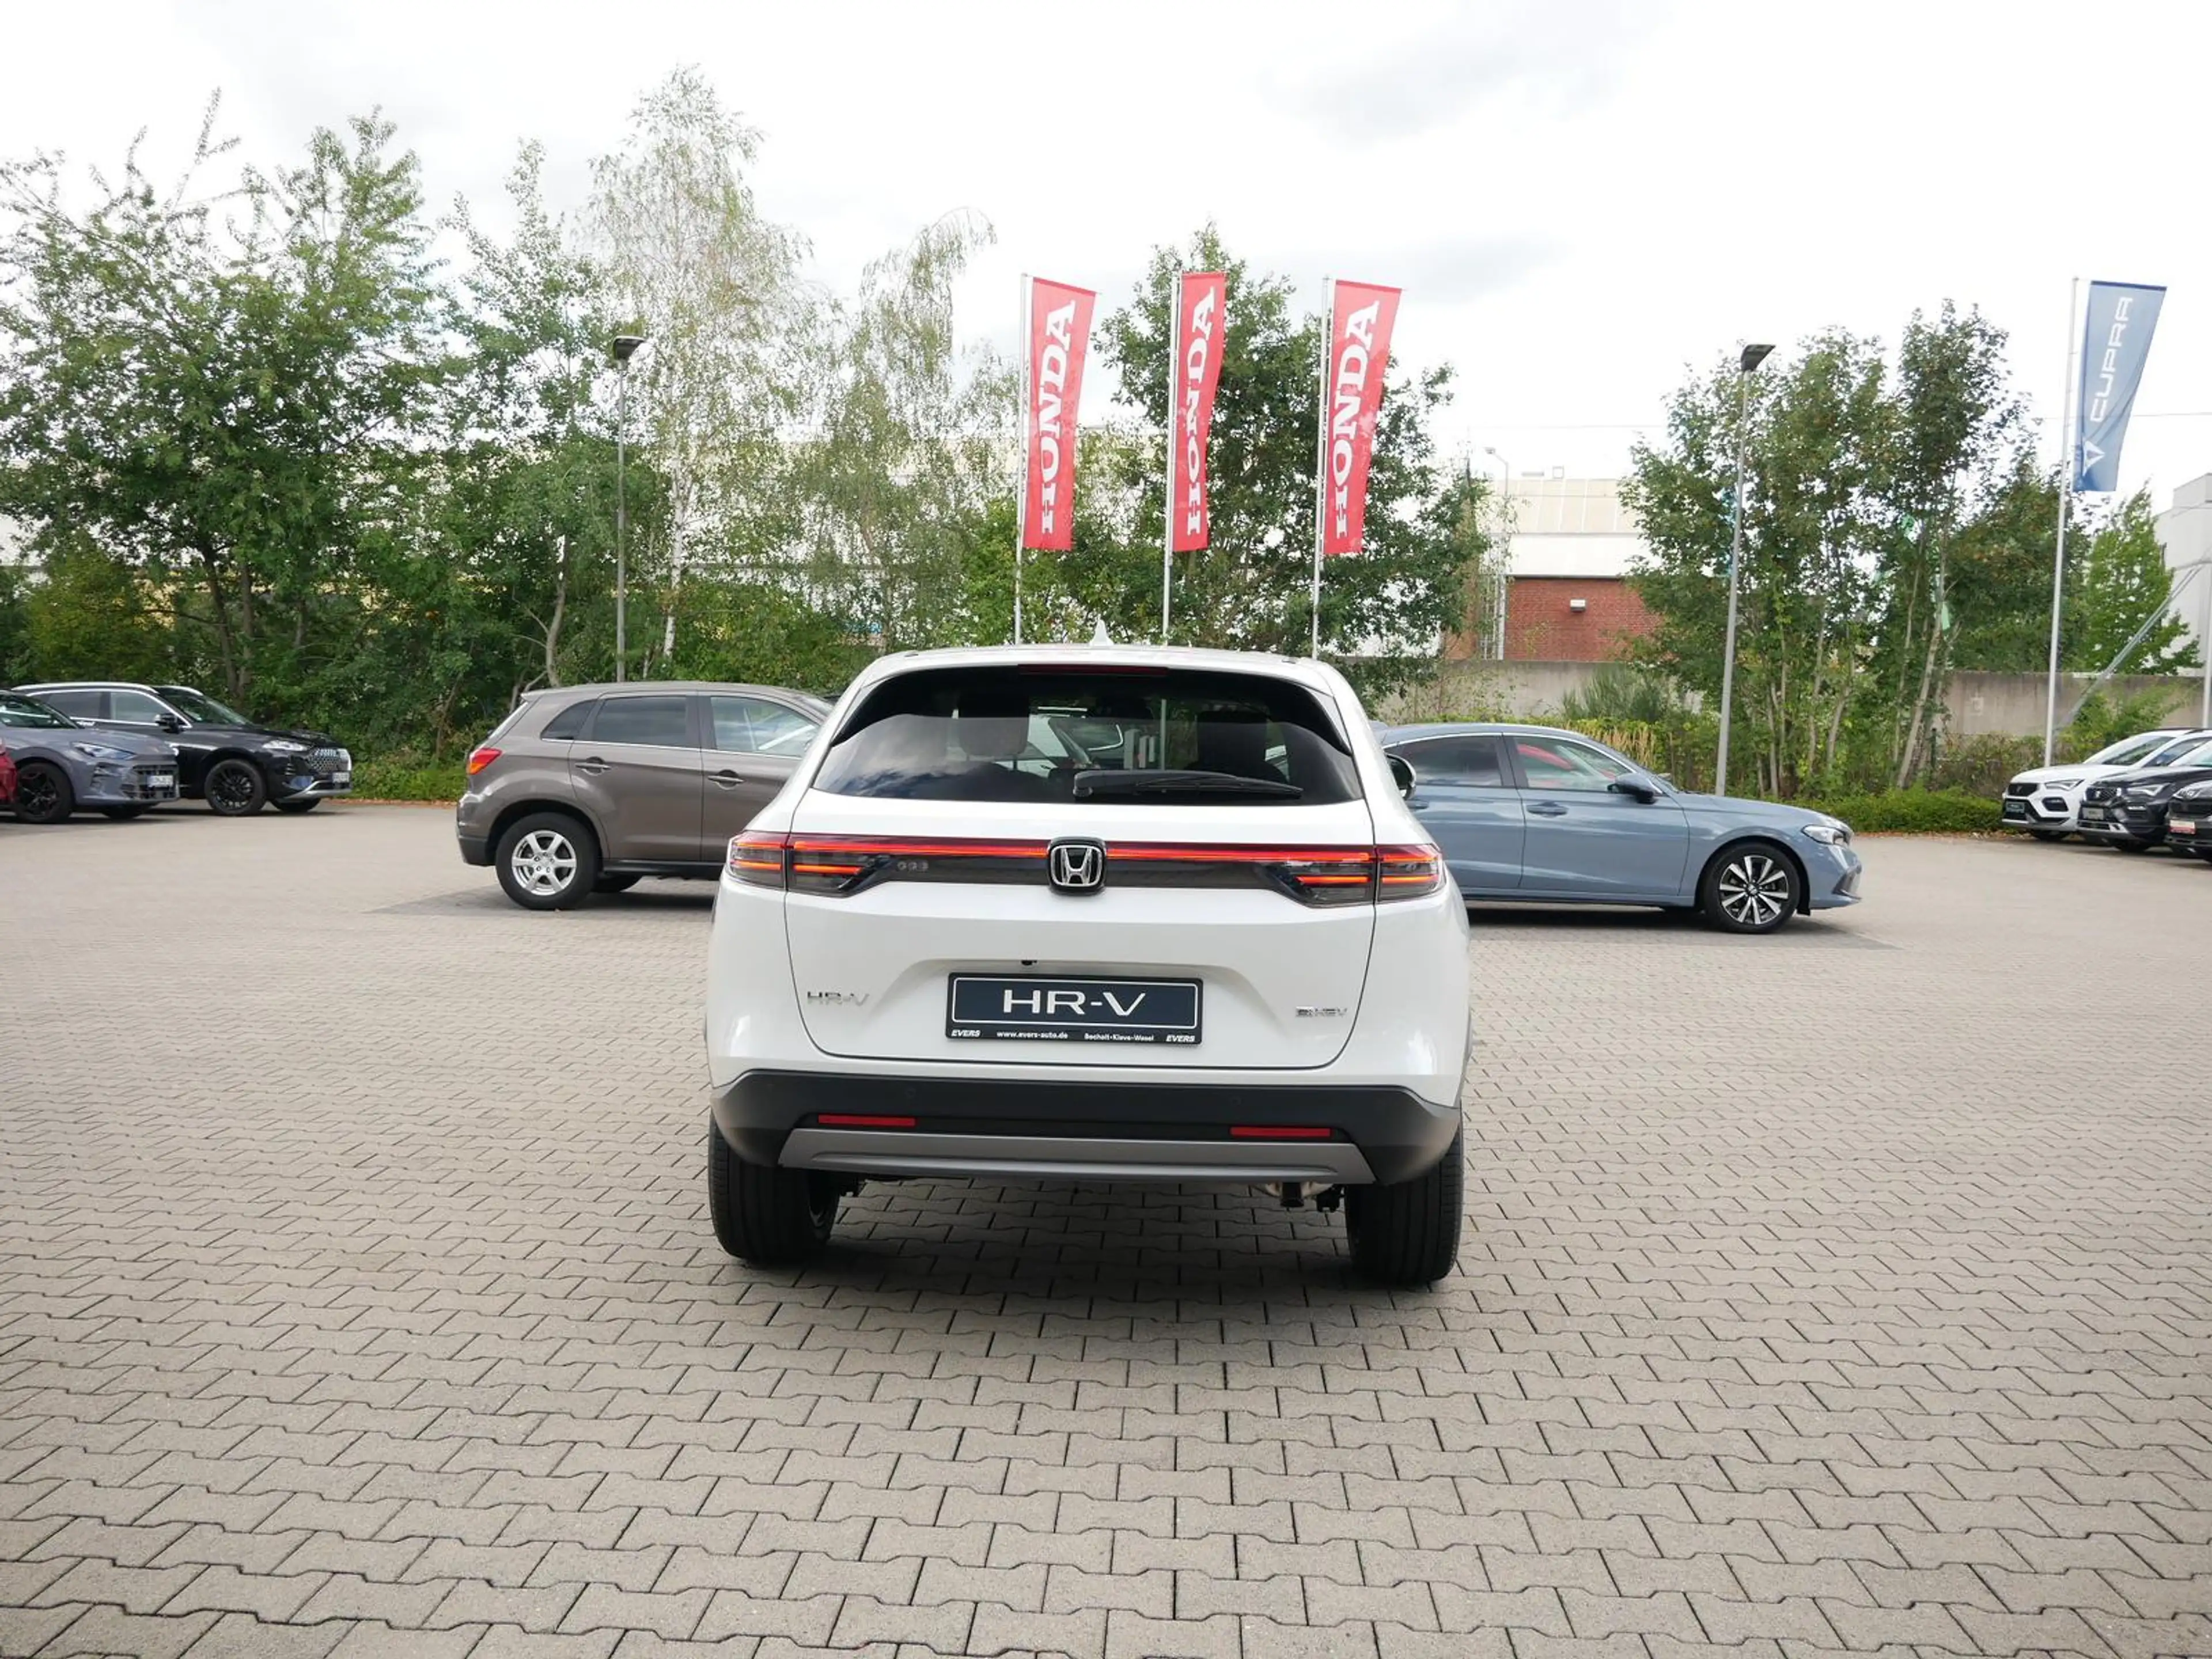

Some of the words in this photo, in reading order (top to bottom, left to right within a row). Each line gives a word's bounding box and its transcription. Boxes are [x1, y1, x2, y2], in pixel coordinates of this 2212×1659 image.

[2089, 296, 2133, 422] CUPRA
[1040, 300, 1075, 535] HONDA
[1186, 286, 1215, 536] HONDA
[1332, 300, 1380, 538] HONDA
[951, 1029, 980, 1037] EVERS
[997, 1031, 1069, 1039] www.evers-auto.de
[1003, 988, 1146, 1017] HR-V
[1166, 1035, 1196, 1043] EVERS
